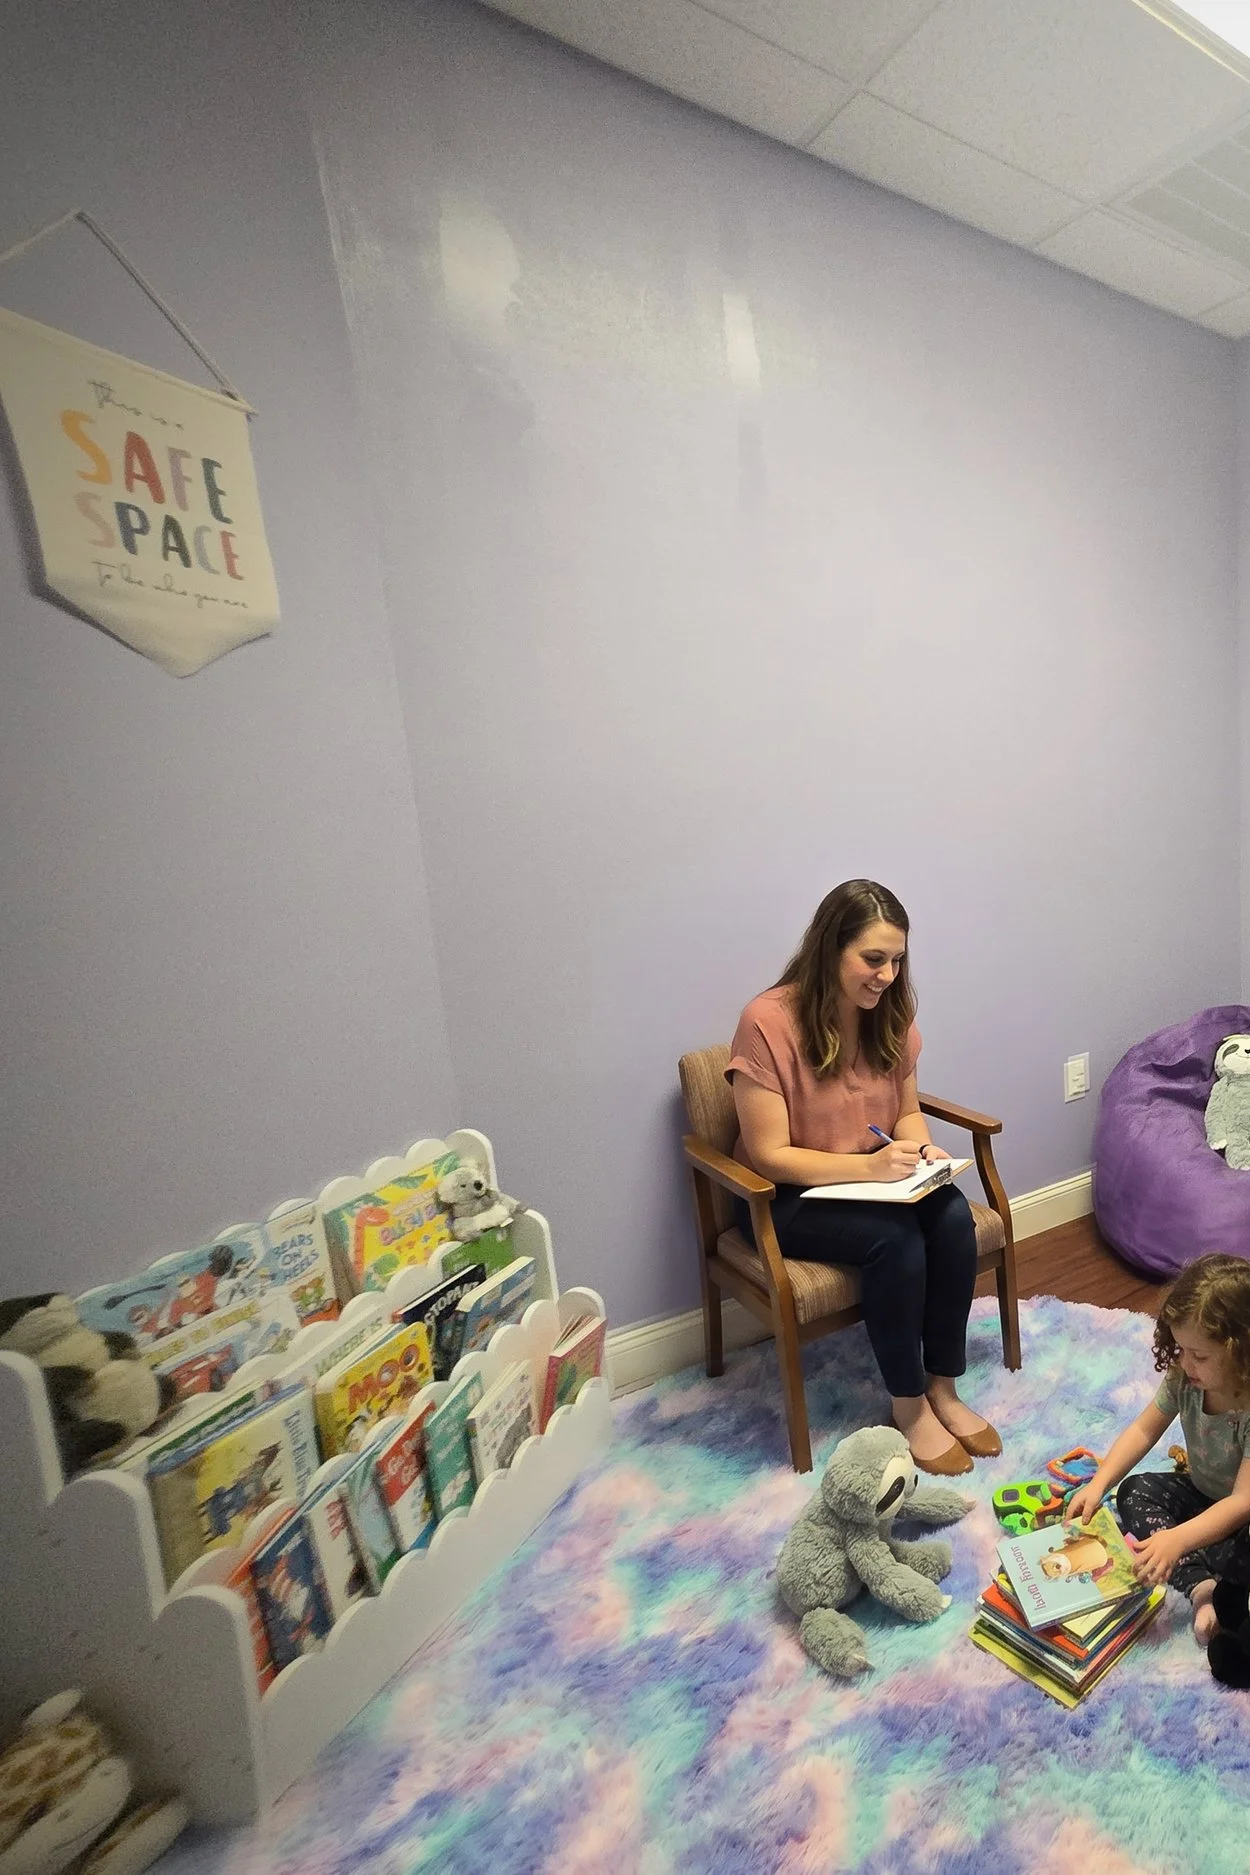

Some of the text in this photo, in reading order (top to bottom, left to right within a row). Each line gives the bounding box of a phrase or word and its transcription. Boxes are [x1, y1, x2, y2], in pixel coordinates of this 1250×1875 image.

[60, 409, 233, 524] SAFE
[75, 492, 245, 581] SPACE
[348, 1343, 420, 1414] MOO
